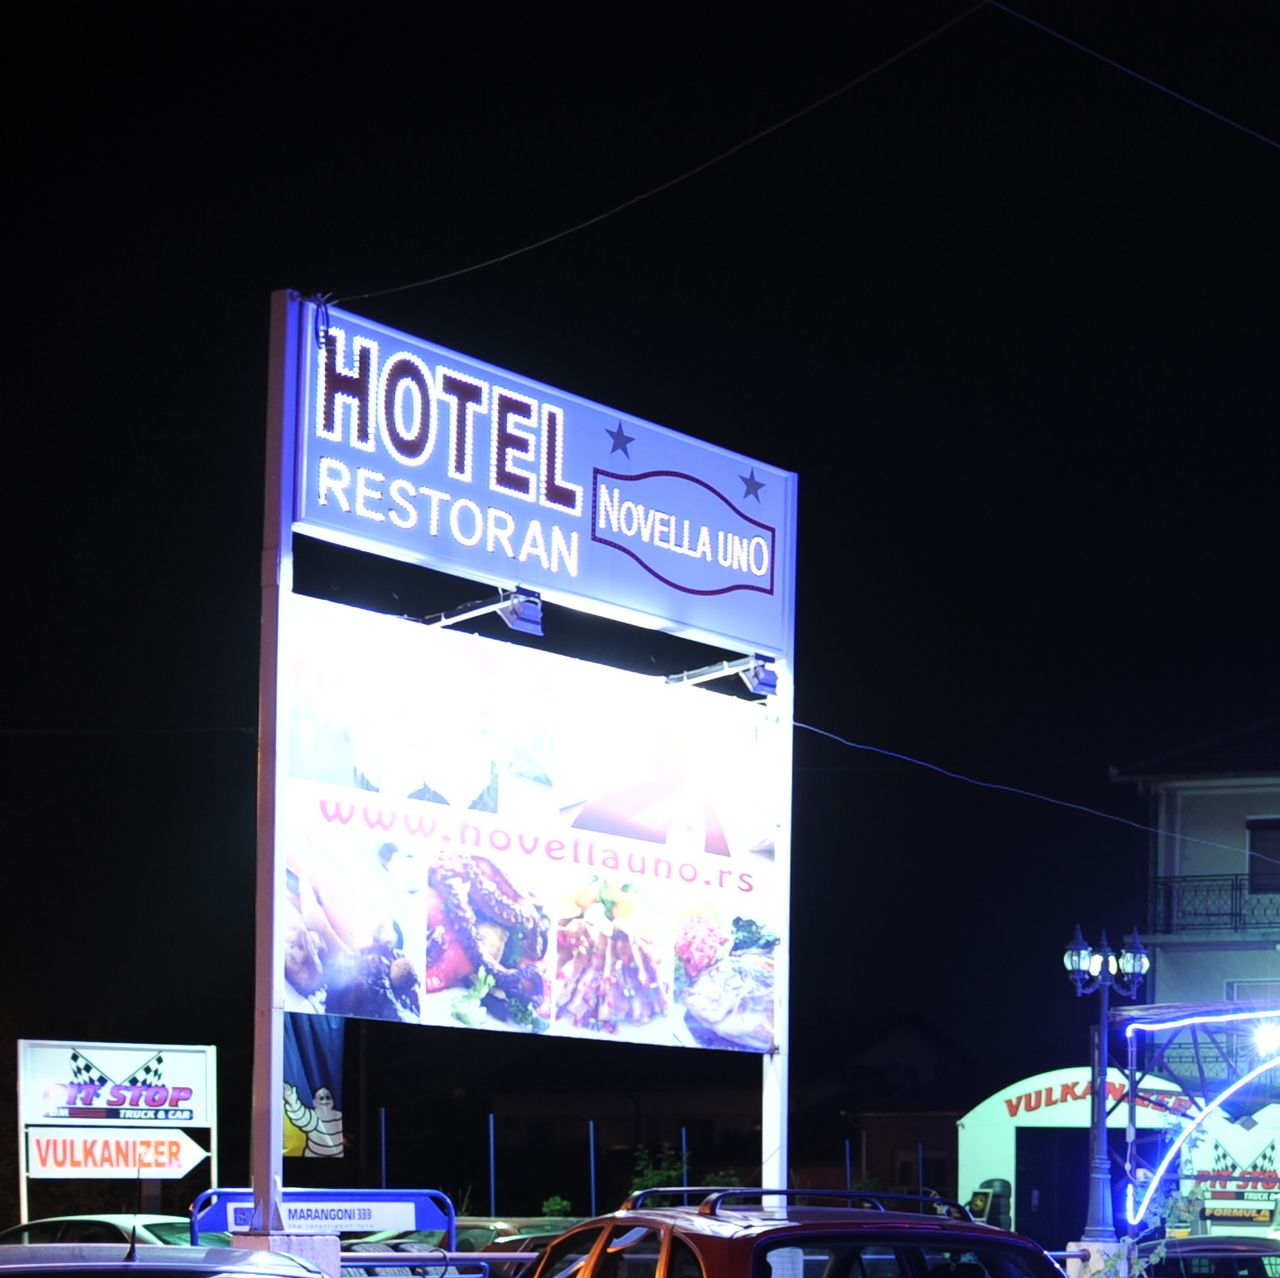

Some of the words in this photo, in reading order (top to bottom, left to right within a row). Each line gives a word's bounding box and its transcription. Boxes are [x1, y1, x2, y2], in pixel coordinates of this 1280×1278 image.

[315, 327, 583, 516] HOTEL
[318, 456, 578, 577] RESTORAN
[599, 485, 712, 561] NOVELLA
[719, 533, 768, 576] UNO
[319, 799, 754, 893] www.novellauno.rs
[106, 1084, 193, 1107] STOP
[120, 1110, 155, 1119] TRUCK
[168, 1110, 190, 1119] CAR
[36, 1139, 181, 1168] VULKANIZER
[288, 1208, 355, 1220] MARANGONI
[1205, 1208, 1270, 1218] FORMULA
